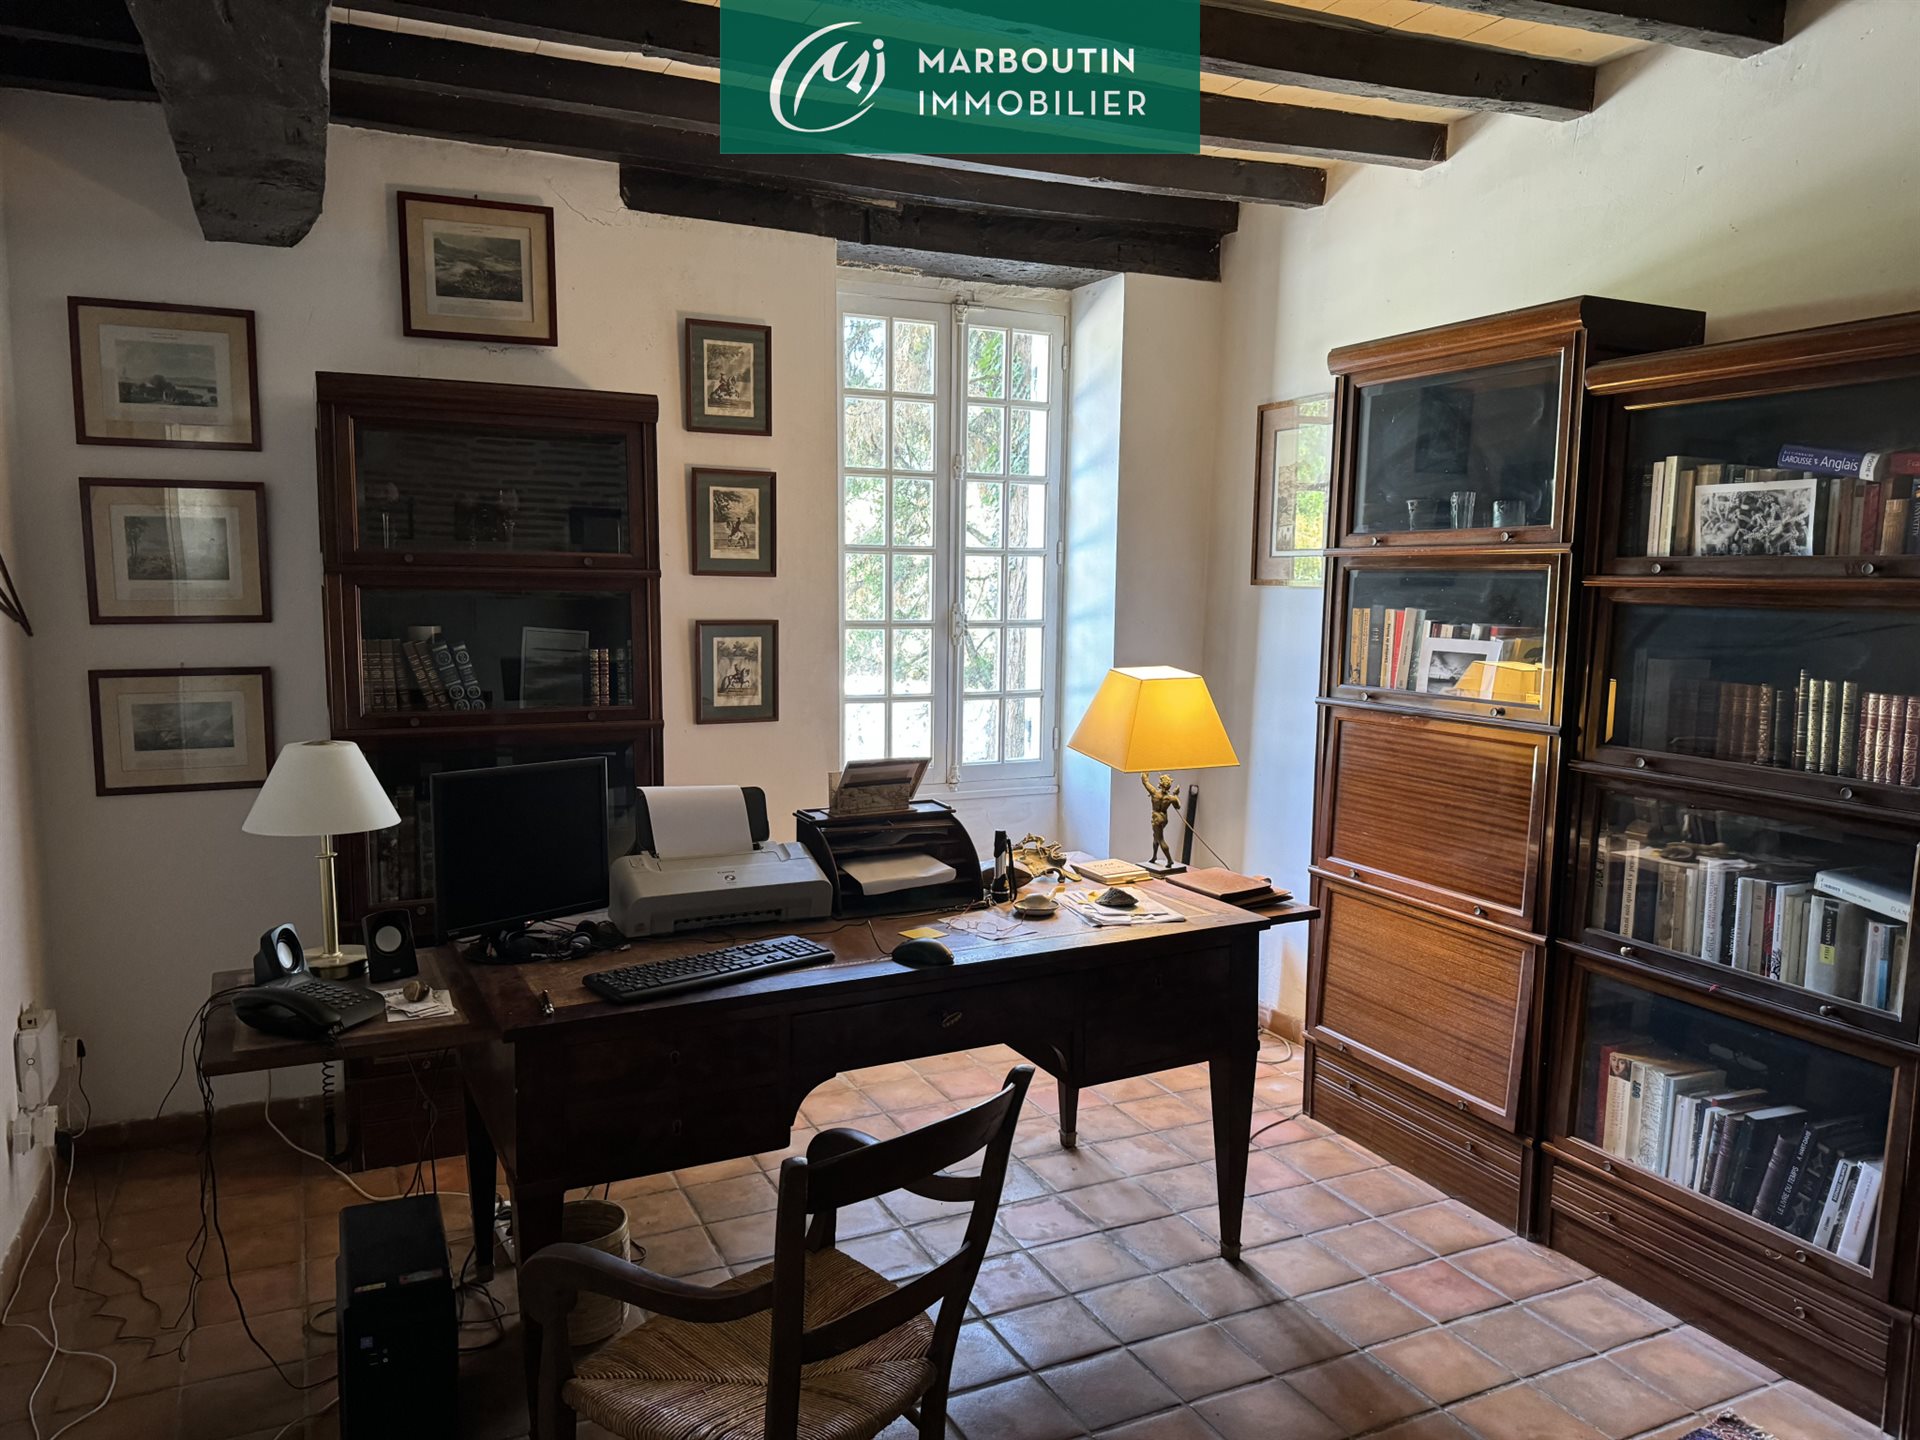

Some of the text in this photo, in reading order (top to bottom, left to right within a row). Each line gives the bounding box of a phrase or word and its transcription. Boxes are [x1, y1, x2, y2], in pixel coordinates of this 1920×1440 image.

[1781, 454, 1859, 472] LAROUSSE Anglais
[1787, 1165, 1799, 1185] TEMPS
[1784, 1183, 1793, 1193] DU
[1780, 1191, 1790, 1209] LIVRE
[1776, 1206, 1784, 1215] LE
